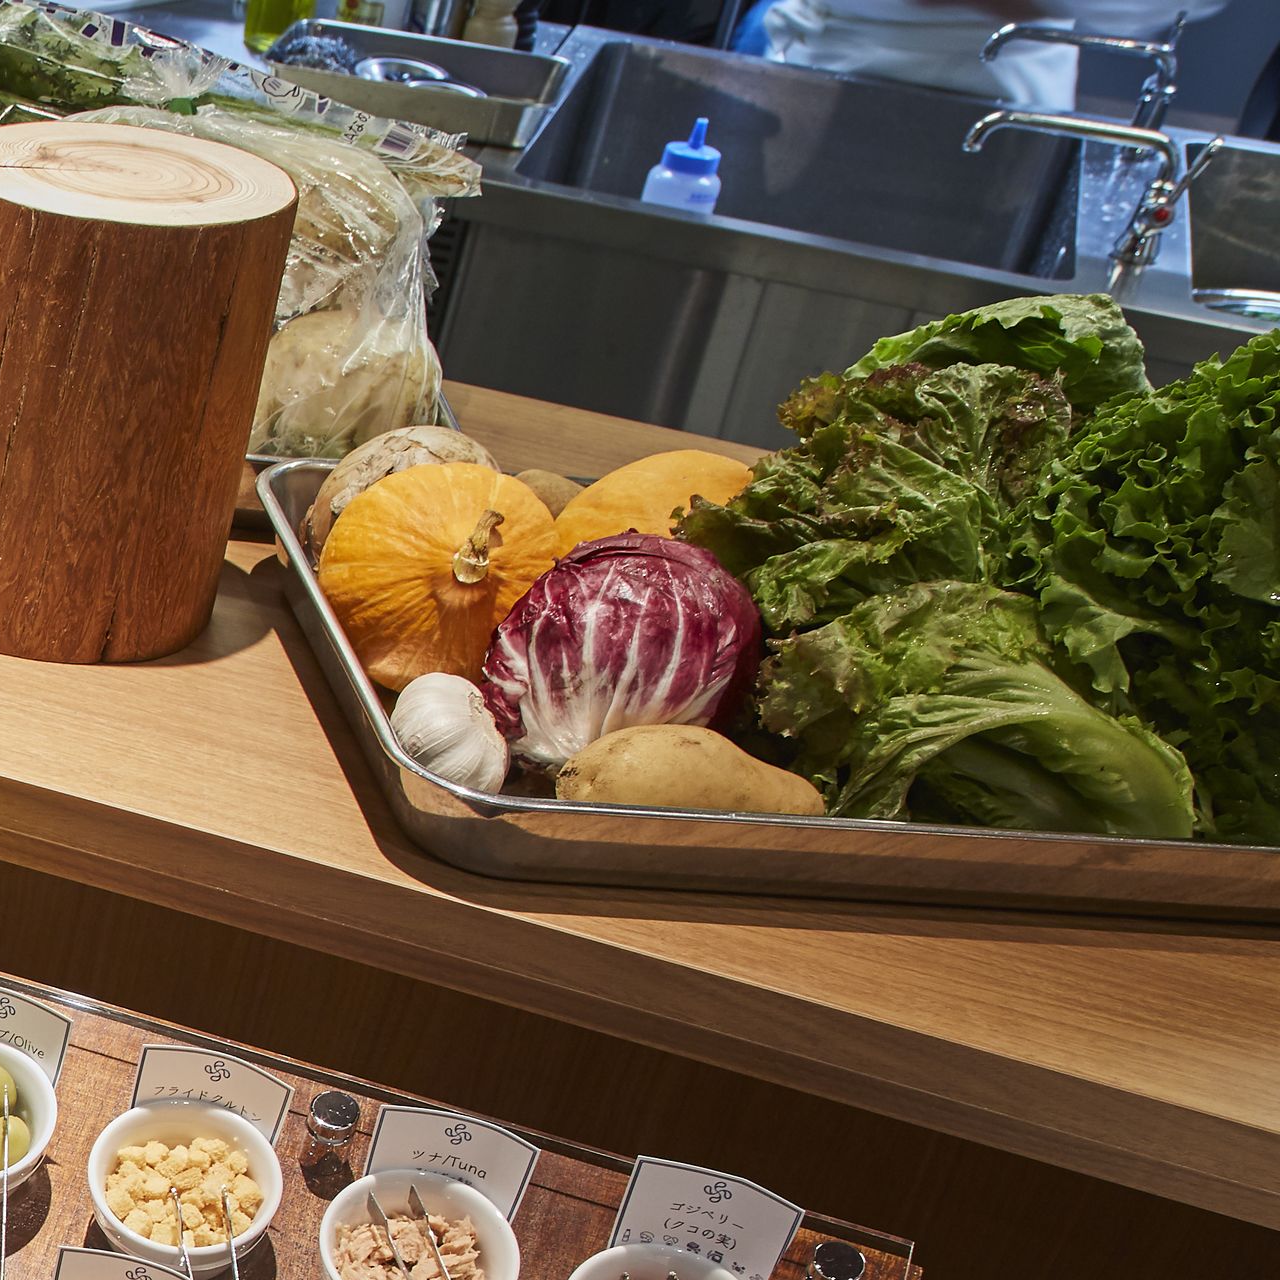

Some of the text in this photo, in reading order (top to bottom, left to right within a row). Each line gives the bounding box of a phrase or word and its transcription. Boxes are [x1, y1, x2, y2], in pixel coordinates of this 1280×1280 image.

[153, 1086, 262, 1122] フライドクルトン
[412, 1150, 488, 1180] ツナ/Tuna
[669, 1202, 745, 1230] ゴジベリー
